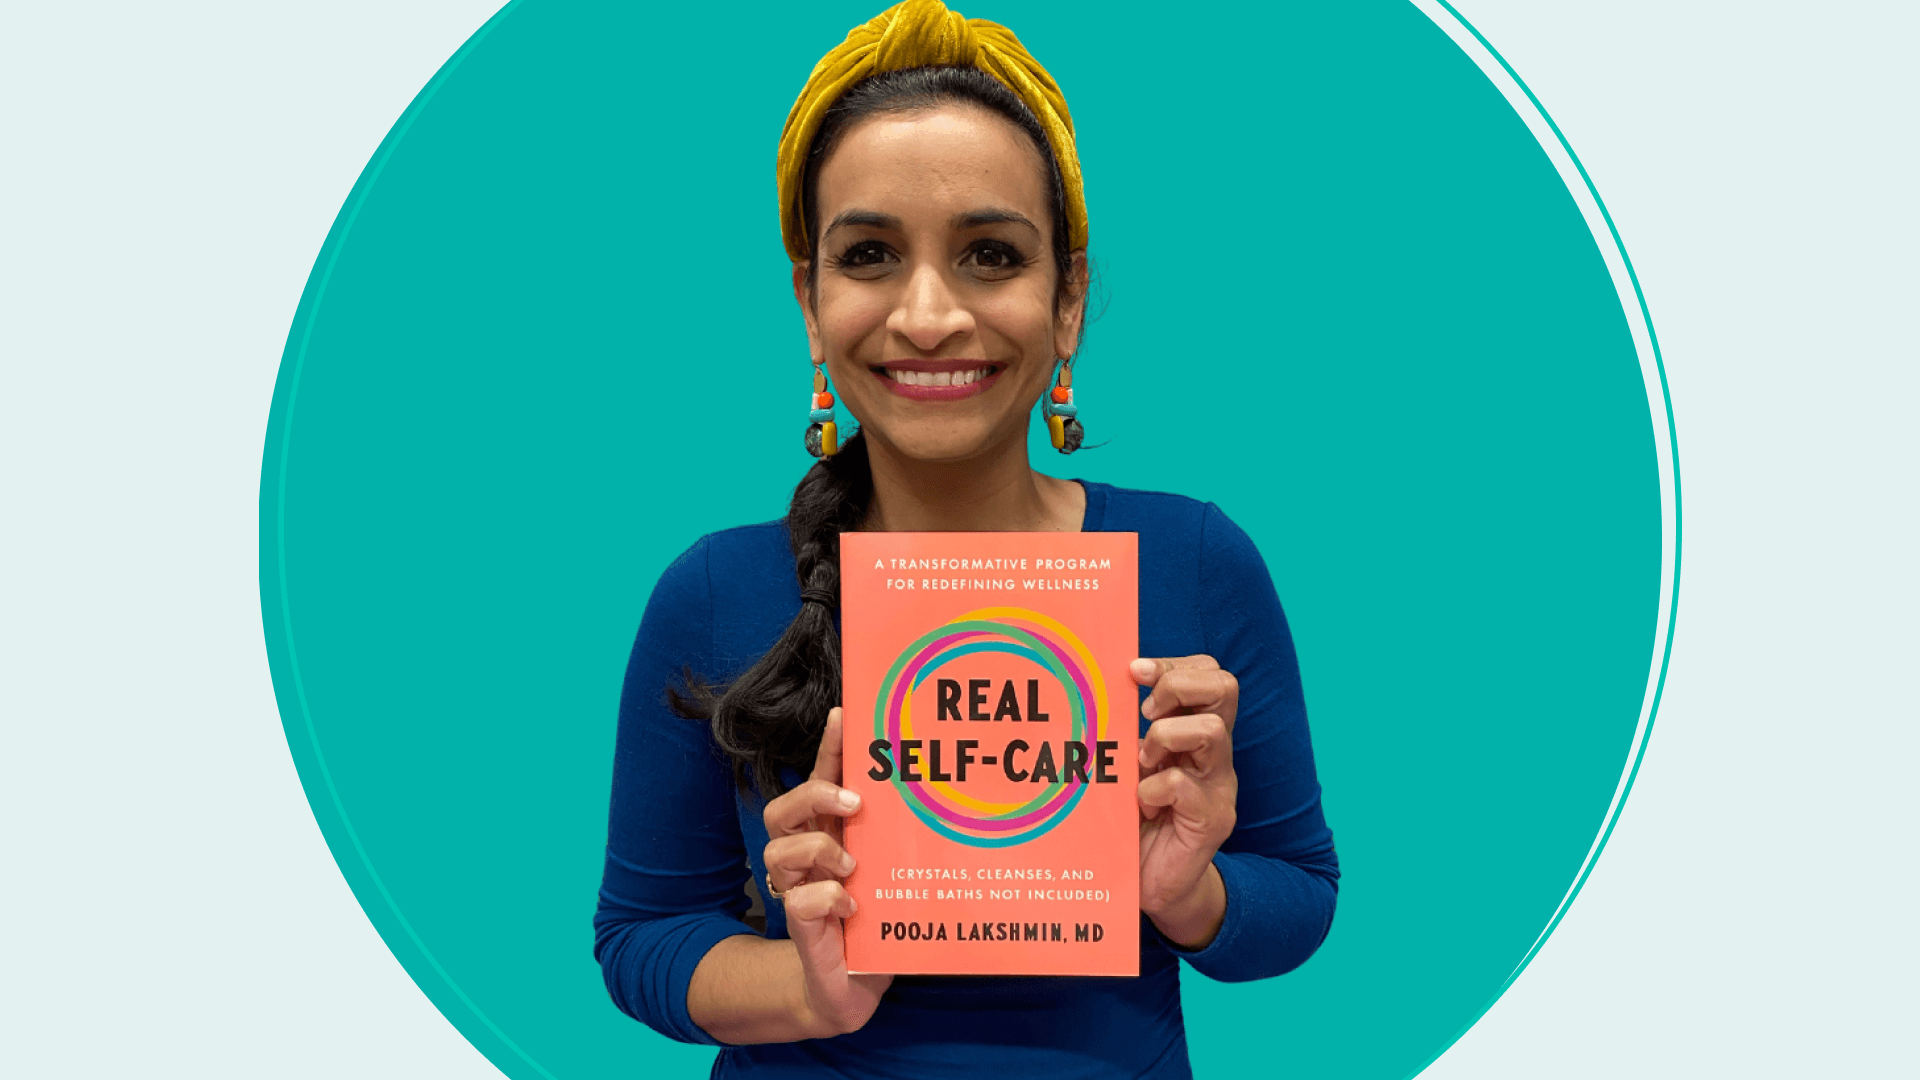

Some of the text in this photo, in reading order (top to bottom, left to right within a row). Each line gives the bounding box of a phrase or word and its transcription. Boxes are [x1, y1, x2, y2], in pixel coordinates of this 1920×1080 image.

[874, 558, 1112, 570] A TRANSFORMATIVE PROGRAM
[887, 578, 1100, 590] FOR REDEFINING WELLNESS
[937, 678, 1049, 722] REAL
[867, 739, 1119, 783] SELF-CARE
[891, 868, 1094, 881] (CRYSTALS, CLEANSES, AND
[876, 889, 1110, 902] BUBBLE BATHS NOT INCLUDED)
[881, 922, 1105, 944] POOJA LAKSHMIN, MD
